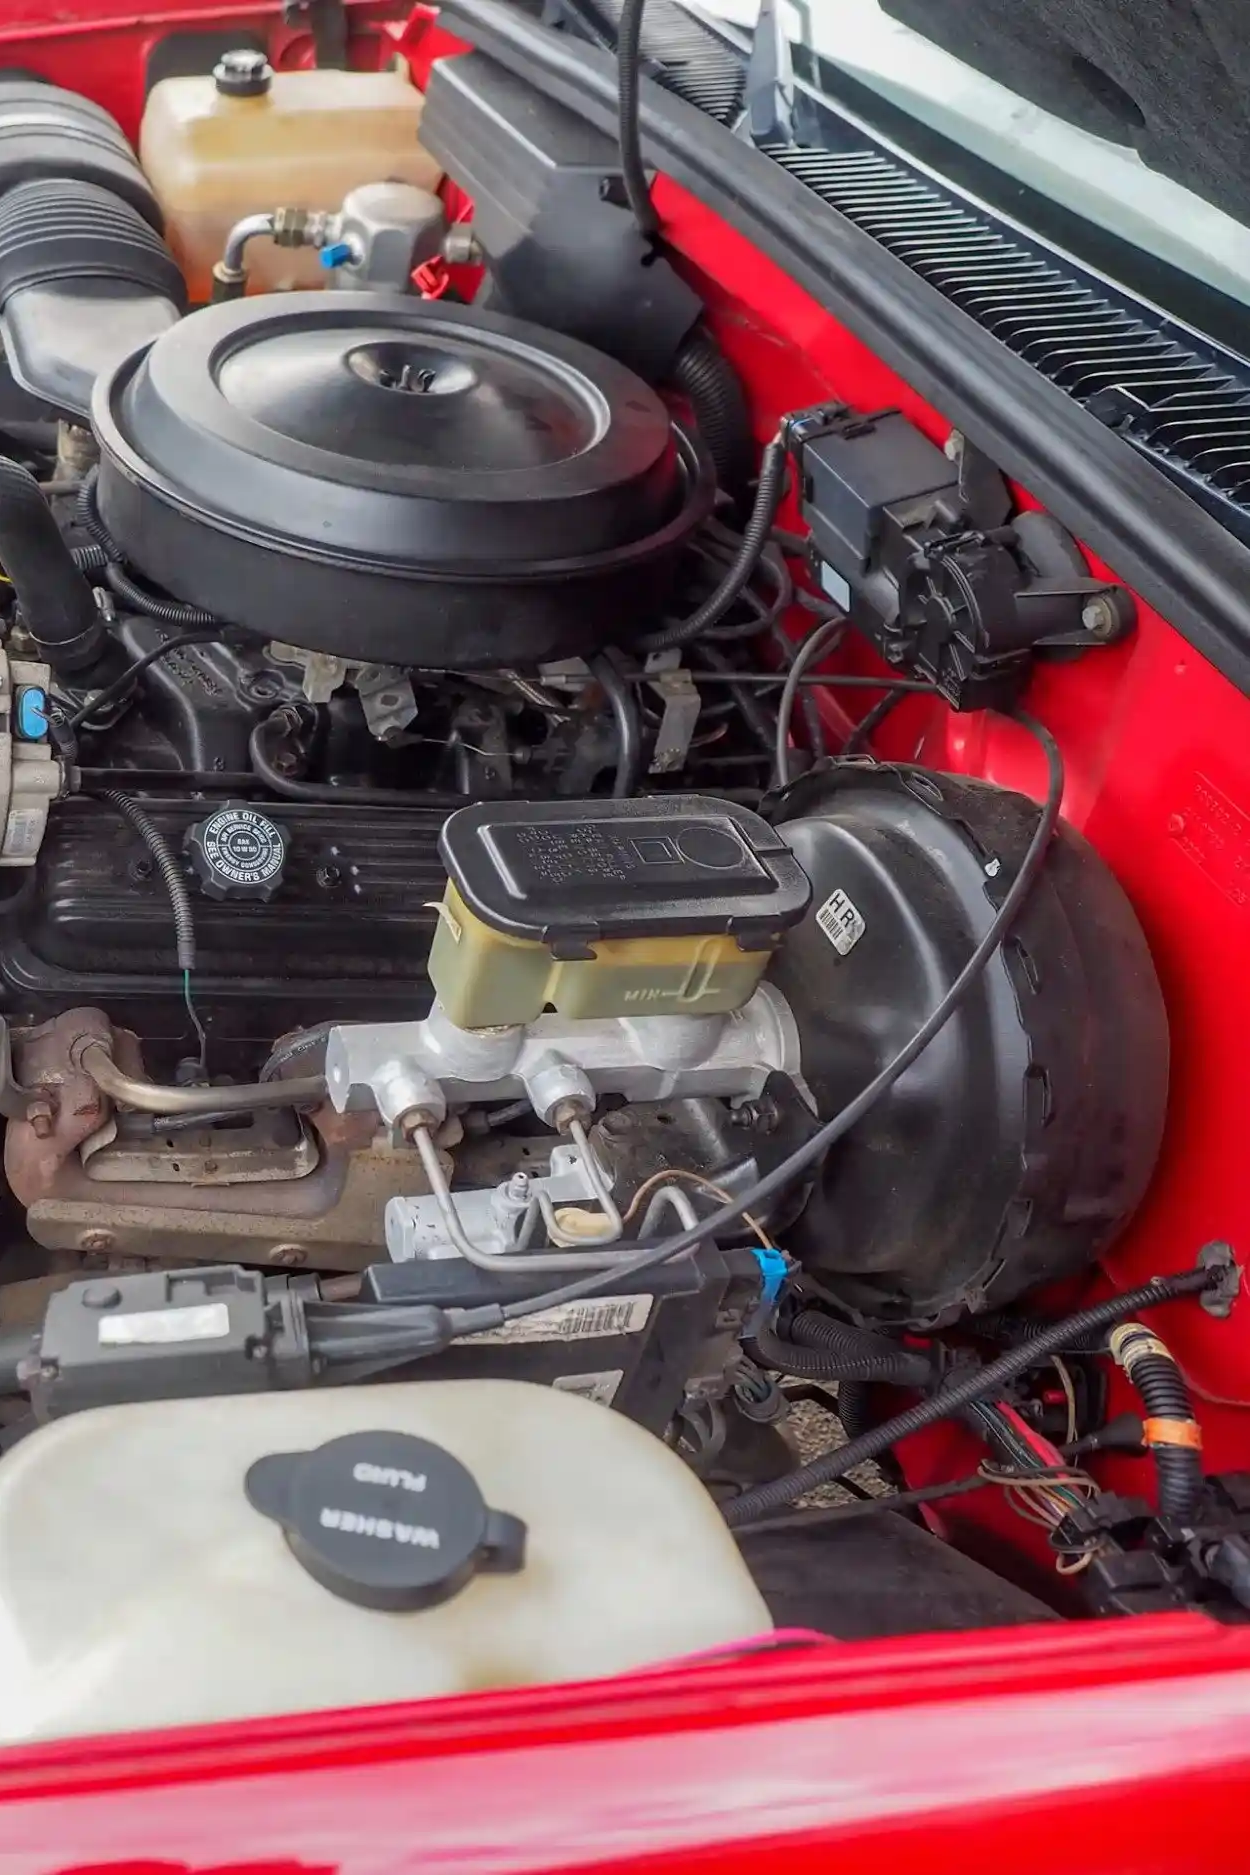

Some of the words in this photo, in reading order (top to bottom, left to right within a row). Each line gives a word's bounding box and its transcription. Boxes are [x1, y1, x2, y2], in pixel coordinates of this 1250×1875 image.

[209, 812, 240, 835] ENGINE
[242, 813, 258, 824] OIL
[260, 820, 276, 838] FILL
[206, 841, 220, 860] SEE
[215, 860, 261, 882] OWNER'S
[261, 842, 281, 877] MANUAL
[623, 988, 660, 1002] MIN
[352, 1462, 427, 1493] FLUID
[319, 1506, 441, 1550] WASHER
